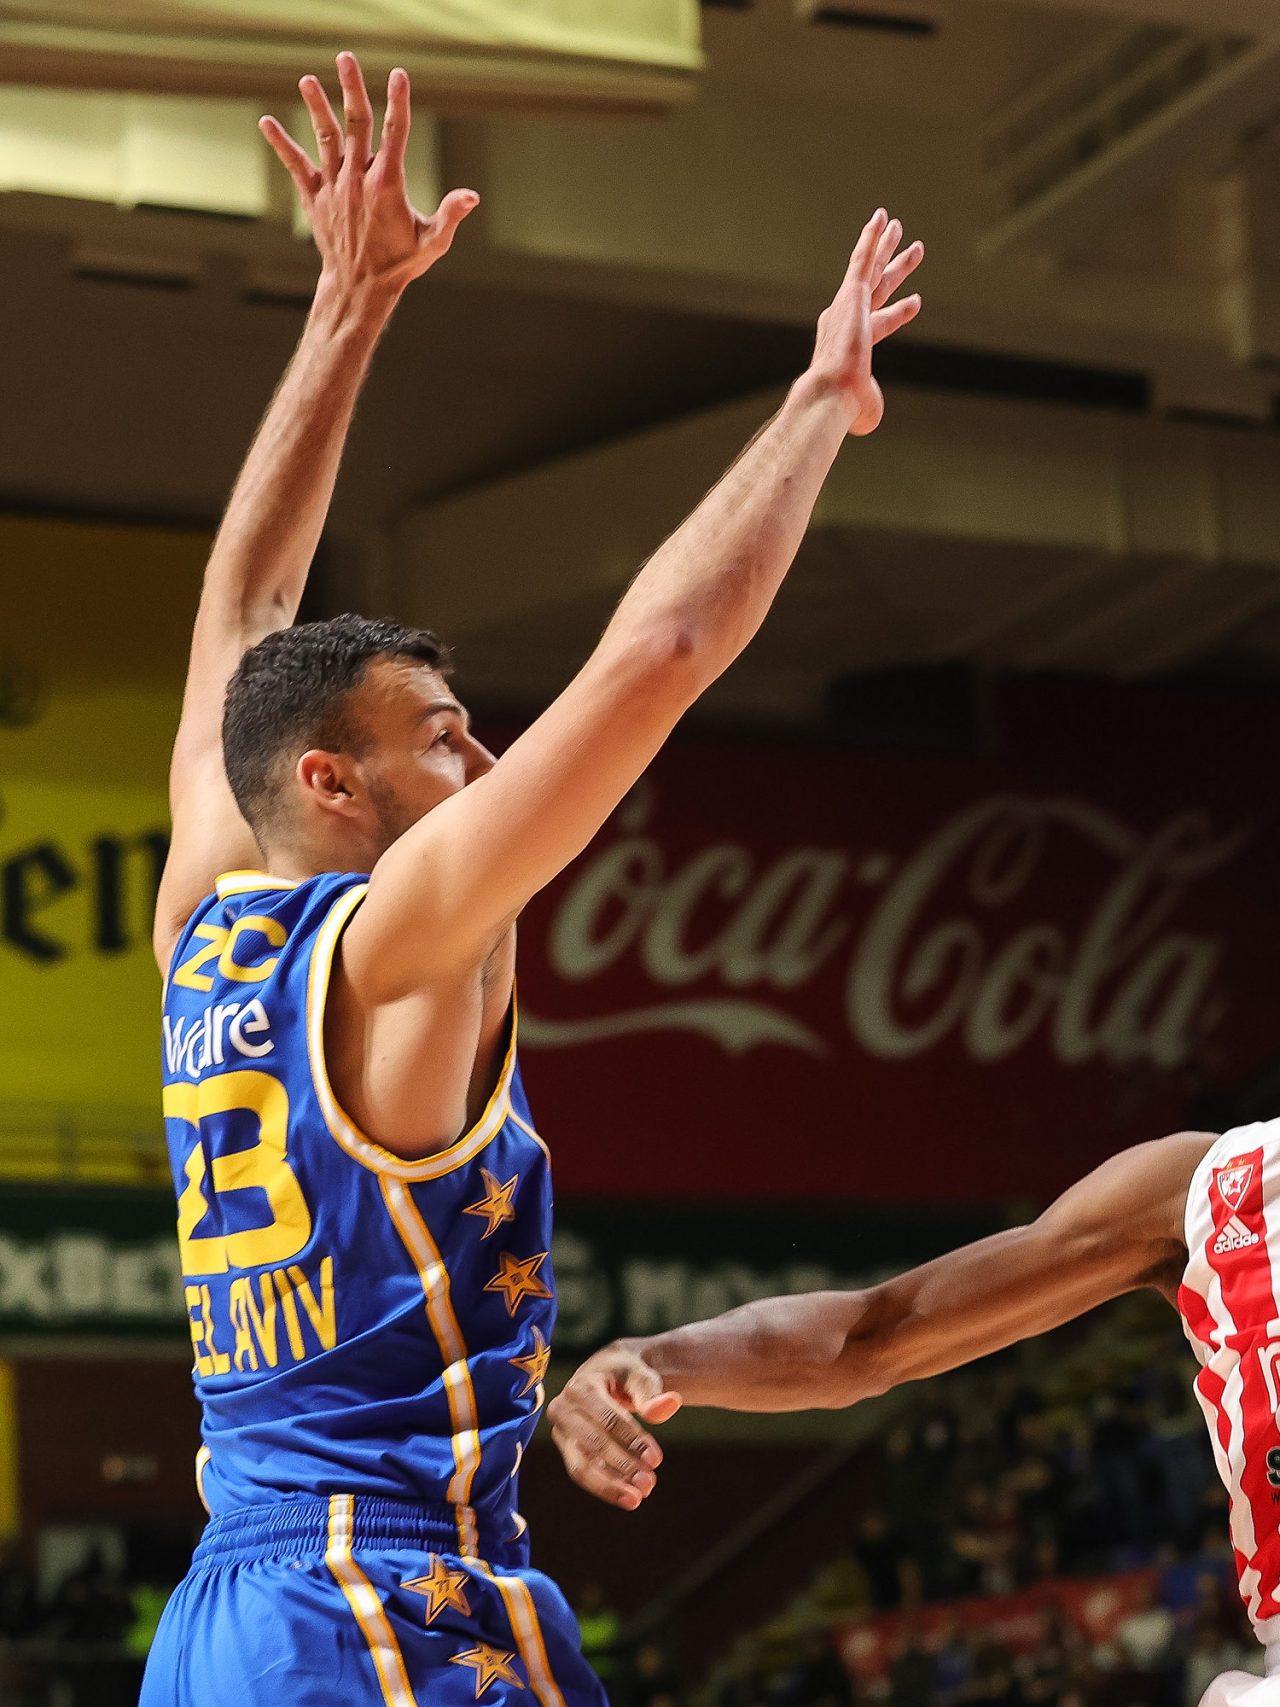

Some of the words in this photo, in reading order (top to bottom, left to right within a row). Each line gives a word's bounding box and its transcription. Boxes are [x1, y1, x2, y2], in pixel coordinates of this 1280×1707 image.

[548, 792, 1250, 1067] oca-Cola
[1213, 1232, 1259, 1254] adidas
[229, 1255, 337, 1373] AVIV
